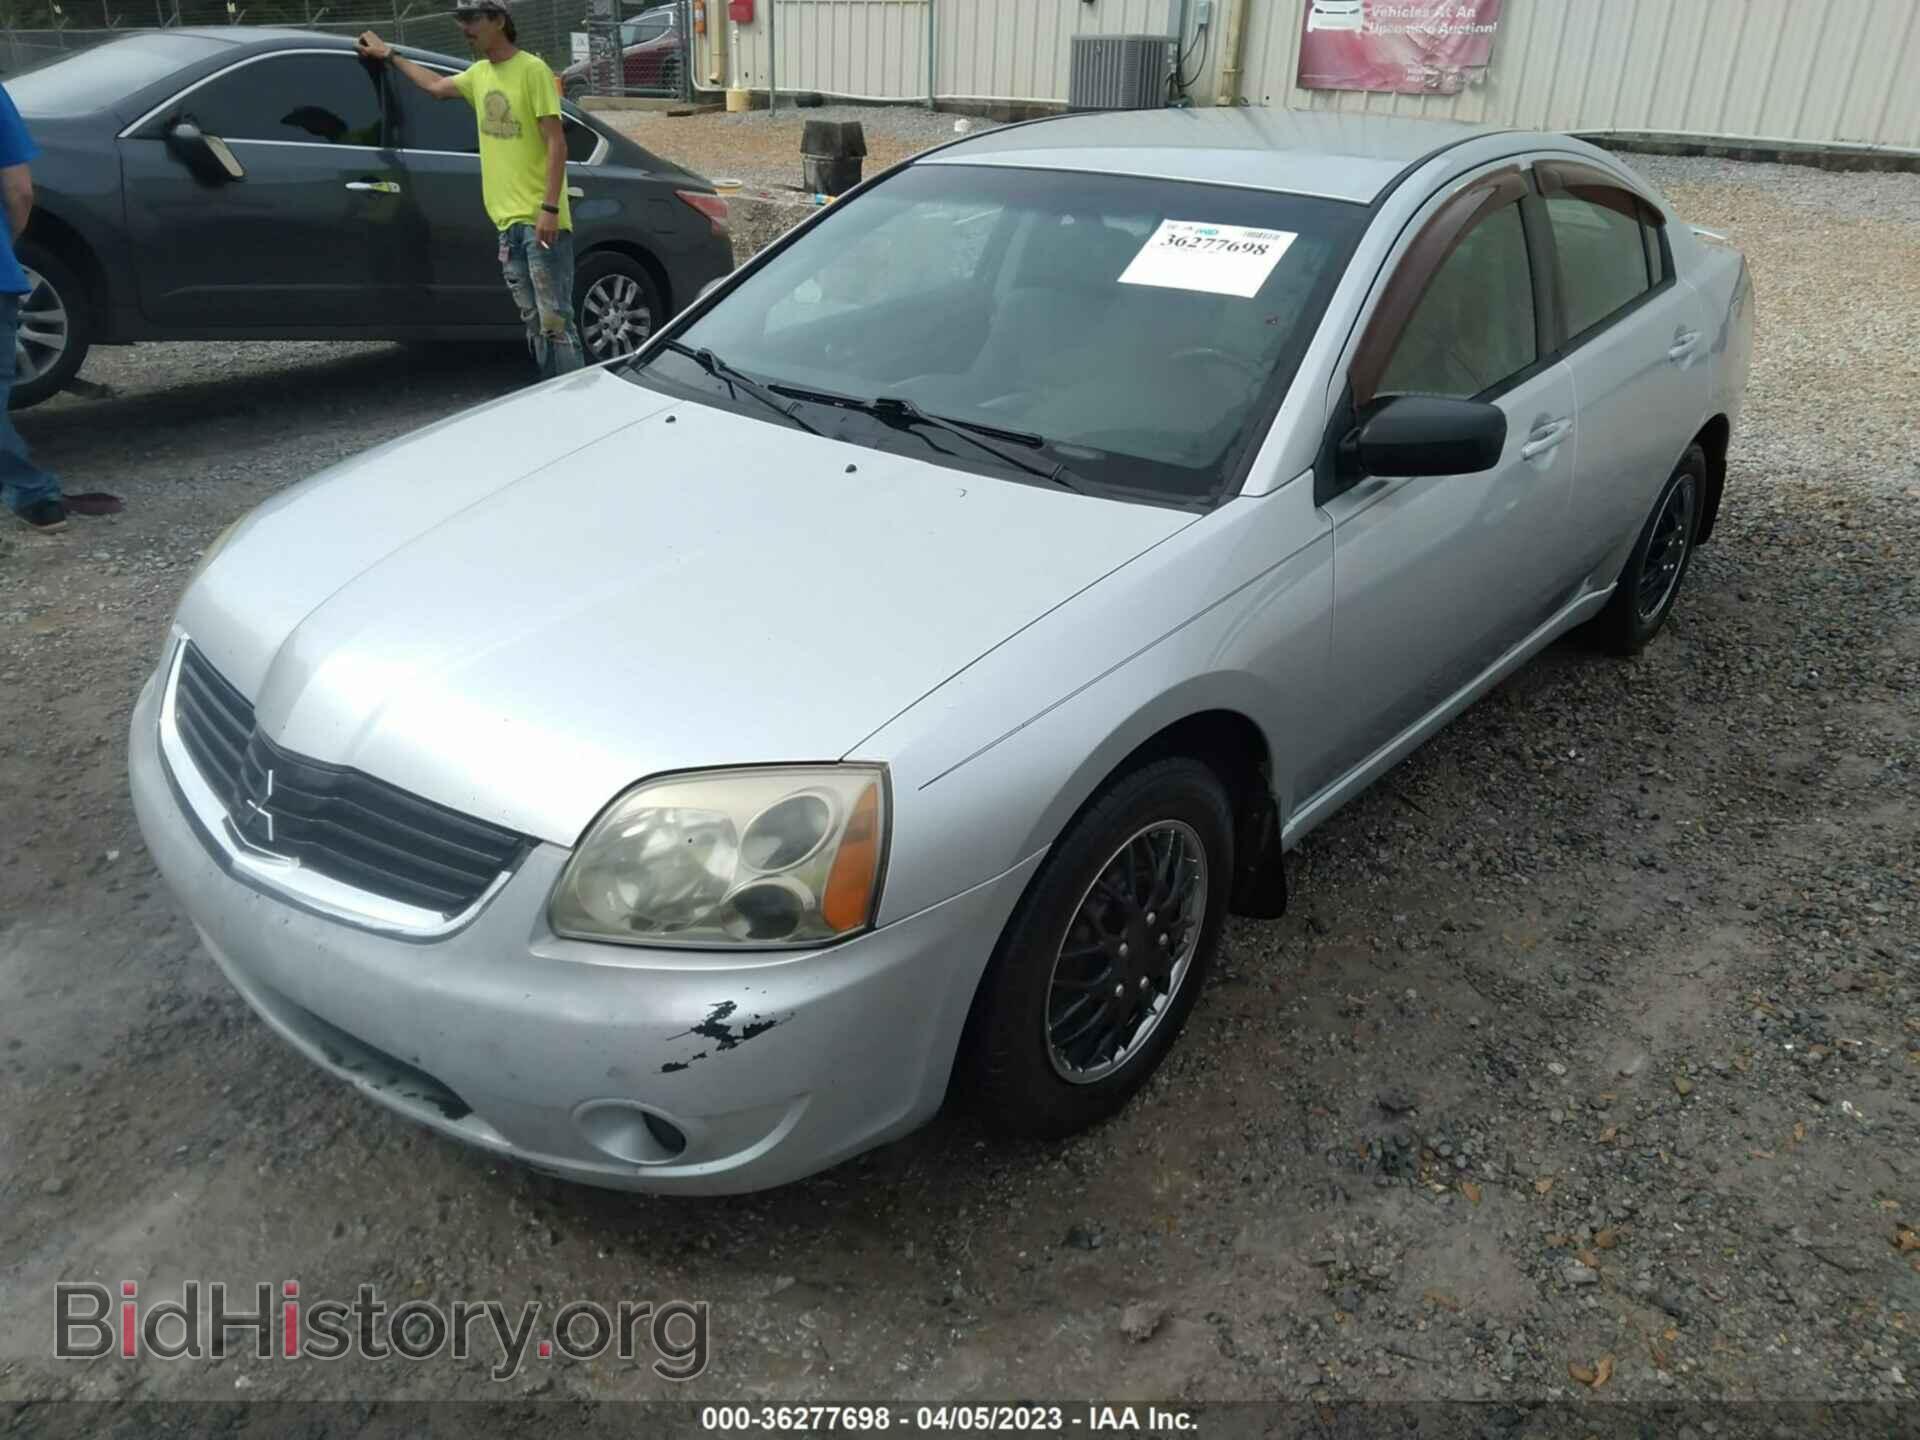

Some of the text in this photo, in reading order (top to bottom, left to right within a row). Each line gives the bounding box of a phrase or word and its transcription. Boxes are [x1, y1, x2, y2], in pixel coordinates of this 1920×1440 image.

[1372, 5, 1430, 18] Vehicles
[1456, 5, 1476, 18] An
[1439, 21, 1498, 34] Auction!
[1160, 233, 1269, 256] 36277698
